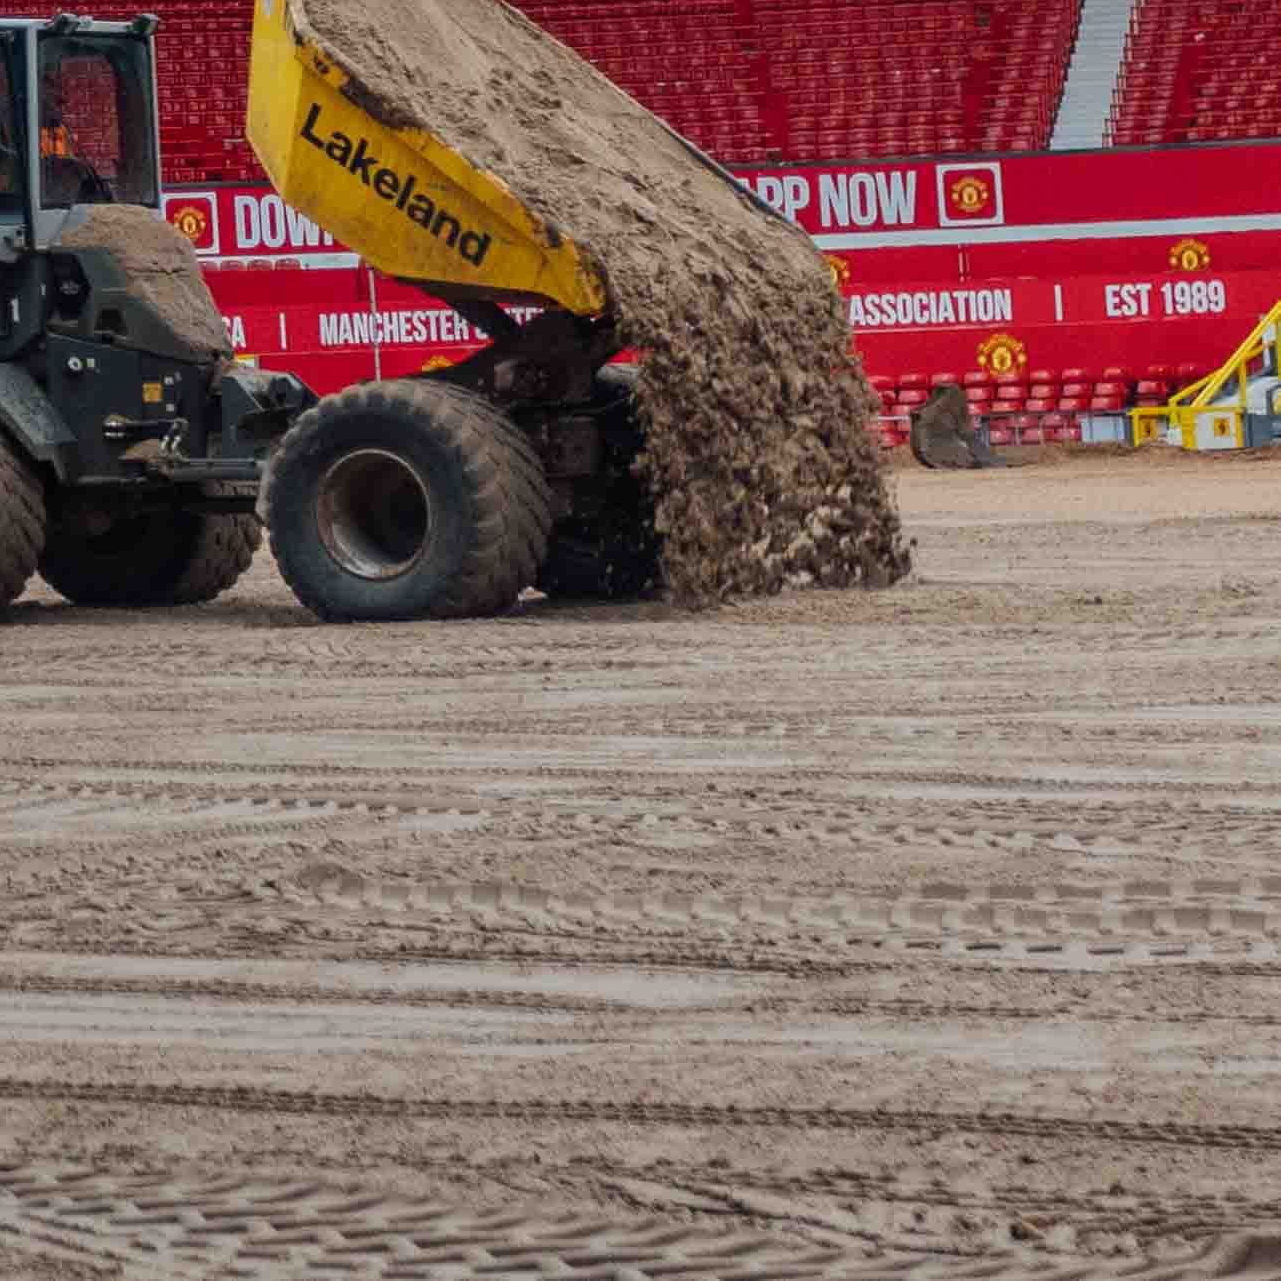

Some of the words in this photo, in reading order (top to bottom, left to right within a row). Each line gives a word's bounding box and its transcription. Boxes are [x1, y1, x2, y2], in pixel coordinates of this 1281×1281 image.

[300, 102, 492, 267] Lakeland
[819, 171, 917, 227] NOW
[849, 288, 1013, 327] ASSOCIATION
[1104, 282, 1152, 318] EST
[1161, 279, 1226, 315] 1989
[319, 310, 469, 347] MANCHESTER
